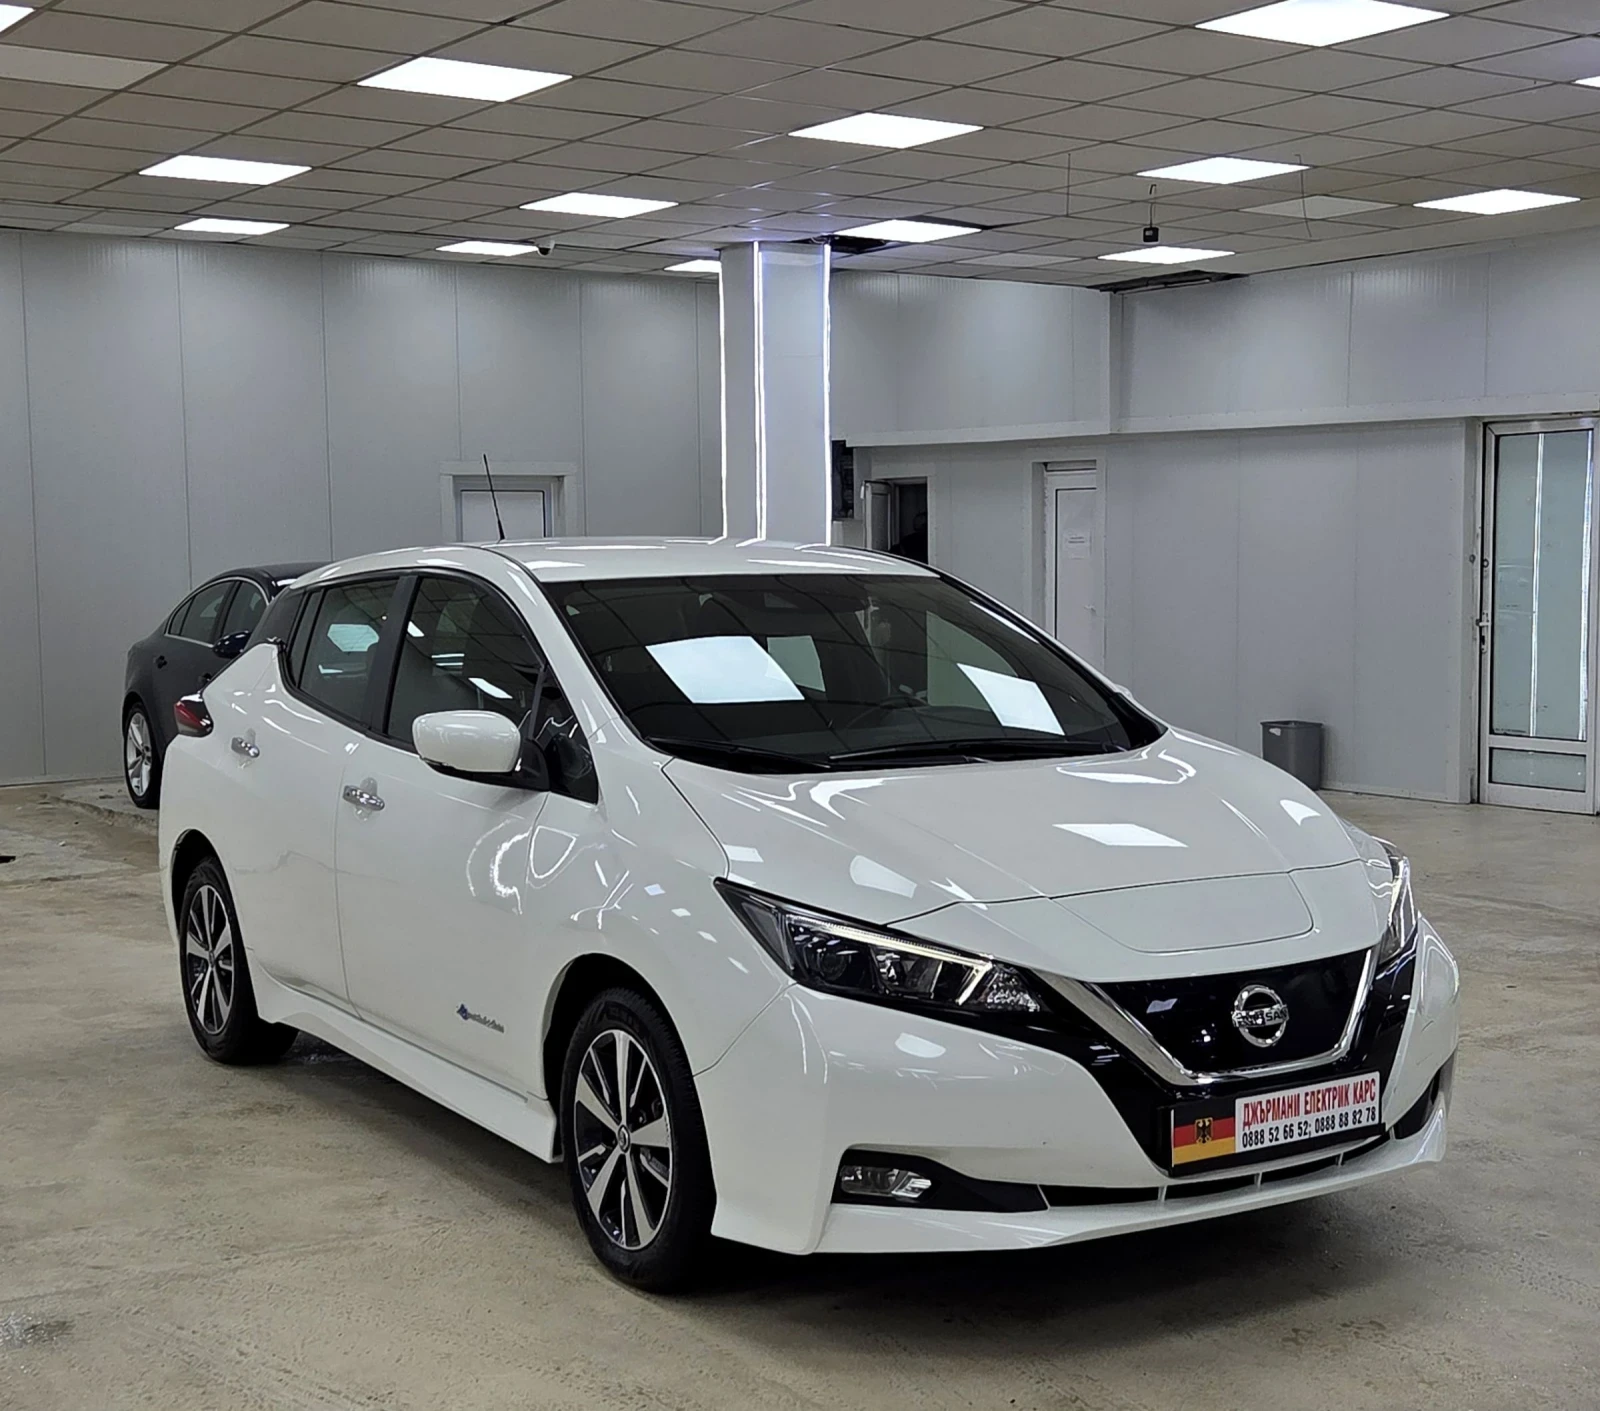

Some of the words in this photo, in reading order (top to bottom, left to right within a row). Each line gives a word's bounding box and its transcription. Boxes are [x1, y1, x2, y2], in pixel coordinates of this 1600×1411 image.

[1243, 1093, 1300, 1131] ДЖЪРМАНИ
[1304, 1084, 1350, 1115] ЕЛЕКТРИК
[1353, 1078, 1376, 1105] КАРС
[1243, 1129, 1264, 1148] 0888
[1269, 1126, 1279, 1143] 52
[1283, 1123, 1294, 1139] 66
[1298, 1120, 1311, 1138] 52;
[1315, 1114, 1335, 1133] 0888
[1339, 1112, 1348, 1128] 88
[1352, 1109, 1362, 1125] 82
[1366, 1106, 1376, 1121] 78
